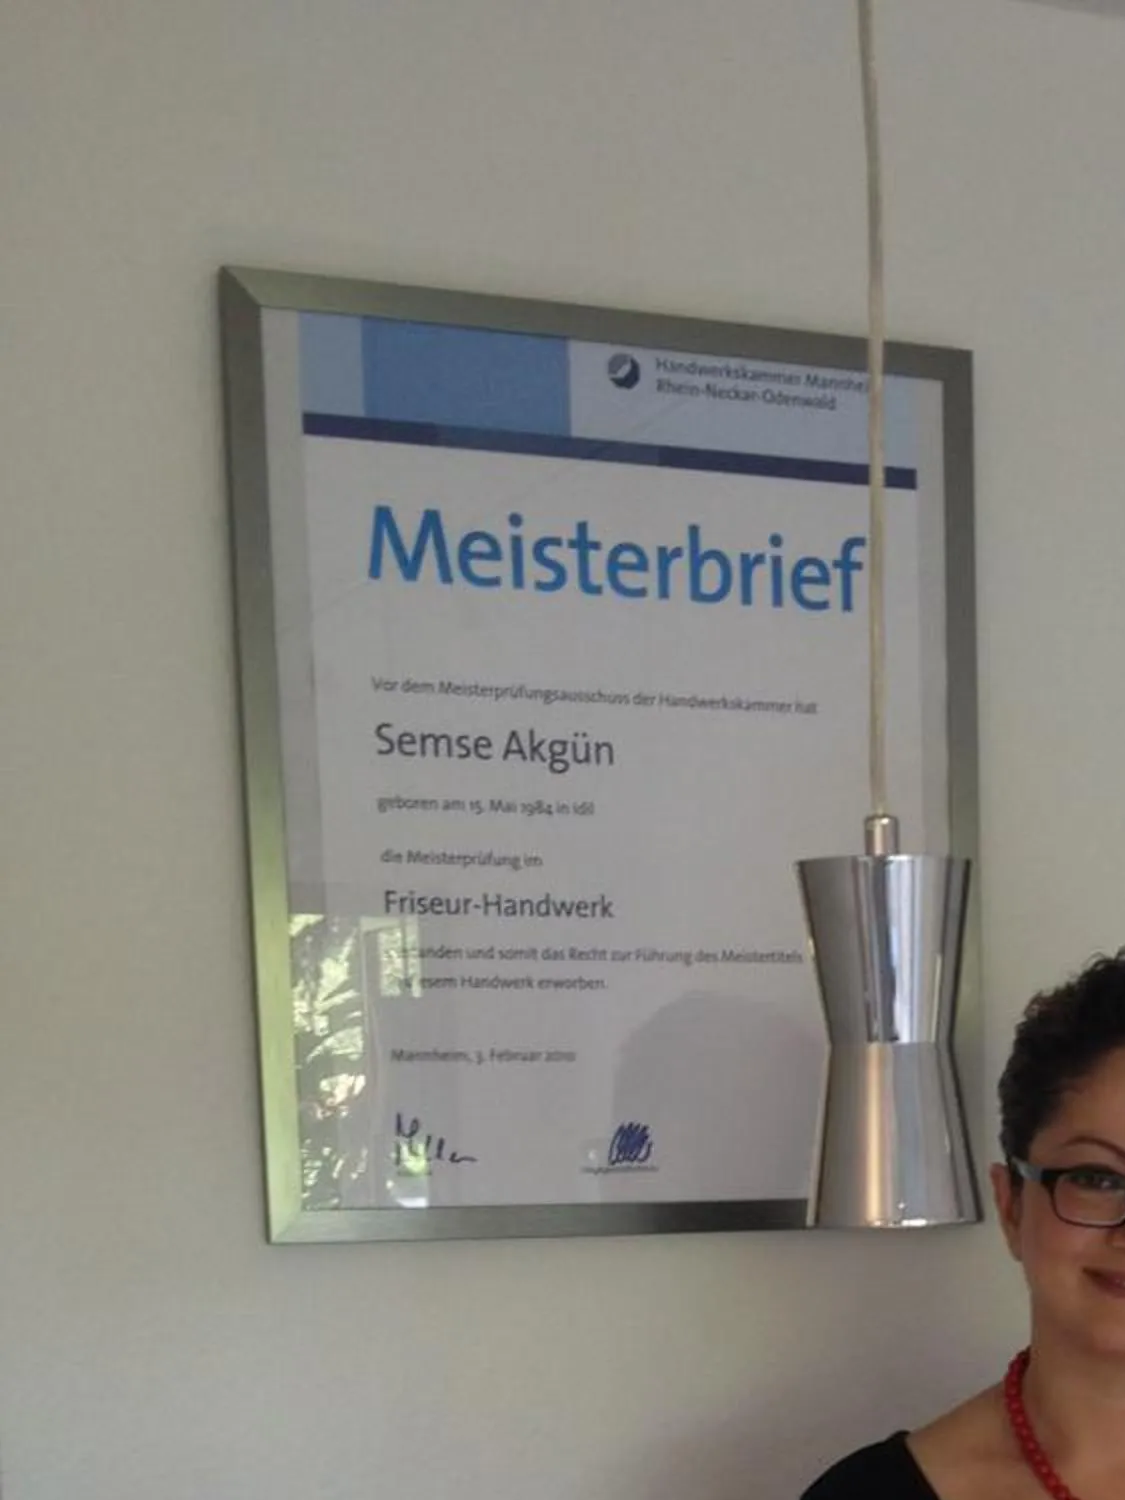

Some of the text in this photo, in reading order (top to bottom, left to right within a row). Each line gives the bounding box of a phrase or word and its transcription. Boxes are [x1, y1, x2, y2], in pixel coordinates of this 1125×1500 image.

[656, 357, 872, 394] Handwerkskammer Mannhei
[368, 506, 867, 614] Meisterbrief
[371, 675, 398, 692] Vor
[402, 678, 434, 694] dem
[633, 690, 657, 707] der
[374, 722, 615, 775] Semse Akgün
[441, 800, 466, 813] am
[380, 849, 544, 871] die Meisterprüfung im
[384, 889, 616, 919] Friseur-Handwerk
[466, 945, 495, 961] und
[499, 945, 538, 963] somit
[541, 946, 565, 962] das
[568, 946, 608, 963] Recht
[635, 947, 692, 967] Führung
[694, 949, 718, 964] des
[461, 974, 534, 991] Handwerk
